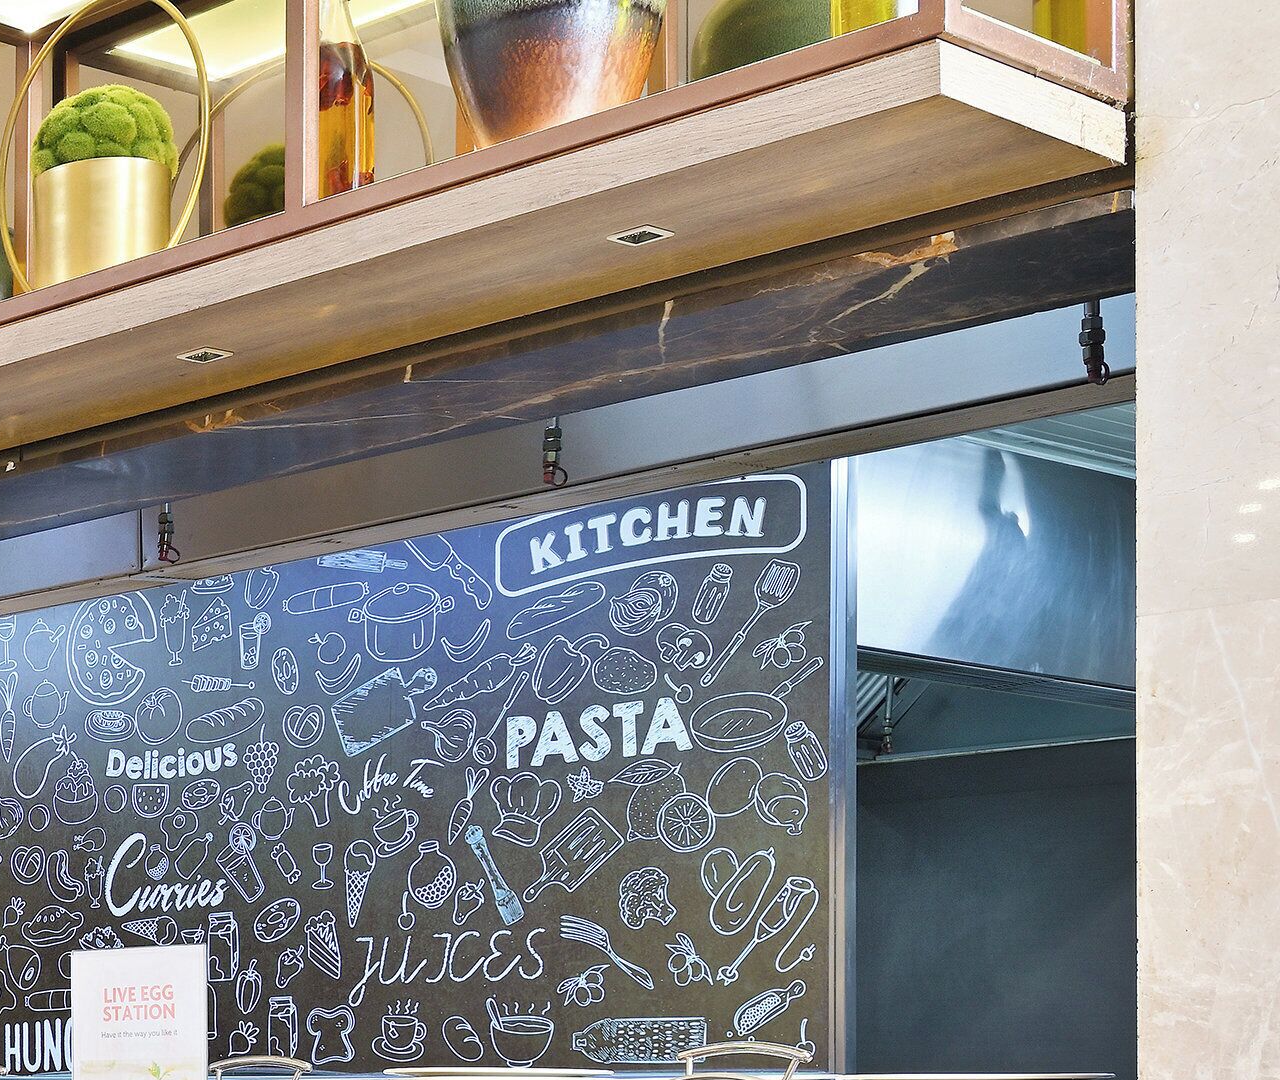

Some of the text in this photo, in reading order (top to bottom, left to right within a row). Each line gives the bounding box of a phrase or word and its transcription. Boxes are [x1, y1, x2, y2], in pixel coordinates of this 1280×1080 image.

[529, 496, 767, 575] KITCHEN
[105, 742, 238, 780] Delicious
[506, 697, 694, 770] PASTA
[338, 753, 445, 815] Coffee Time
[104, 832, 230, 917] Curries
[104, 984, 174, 1003] LIVE EGG
[348, 927, 546, 1008] JUICES
[103, 1003, 175, 1021] STATION
[134, 1031, 147, 1039] way
[148, 1031, 160, 1039] you
[161, 1029, 172, 1037] like
